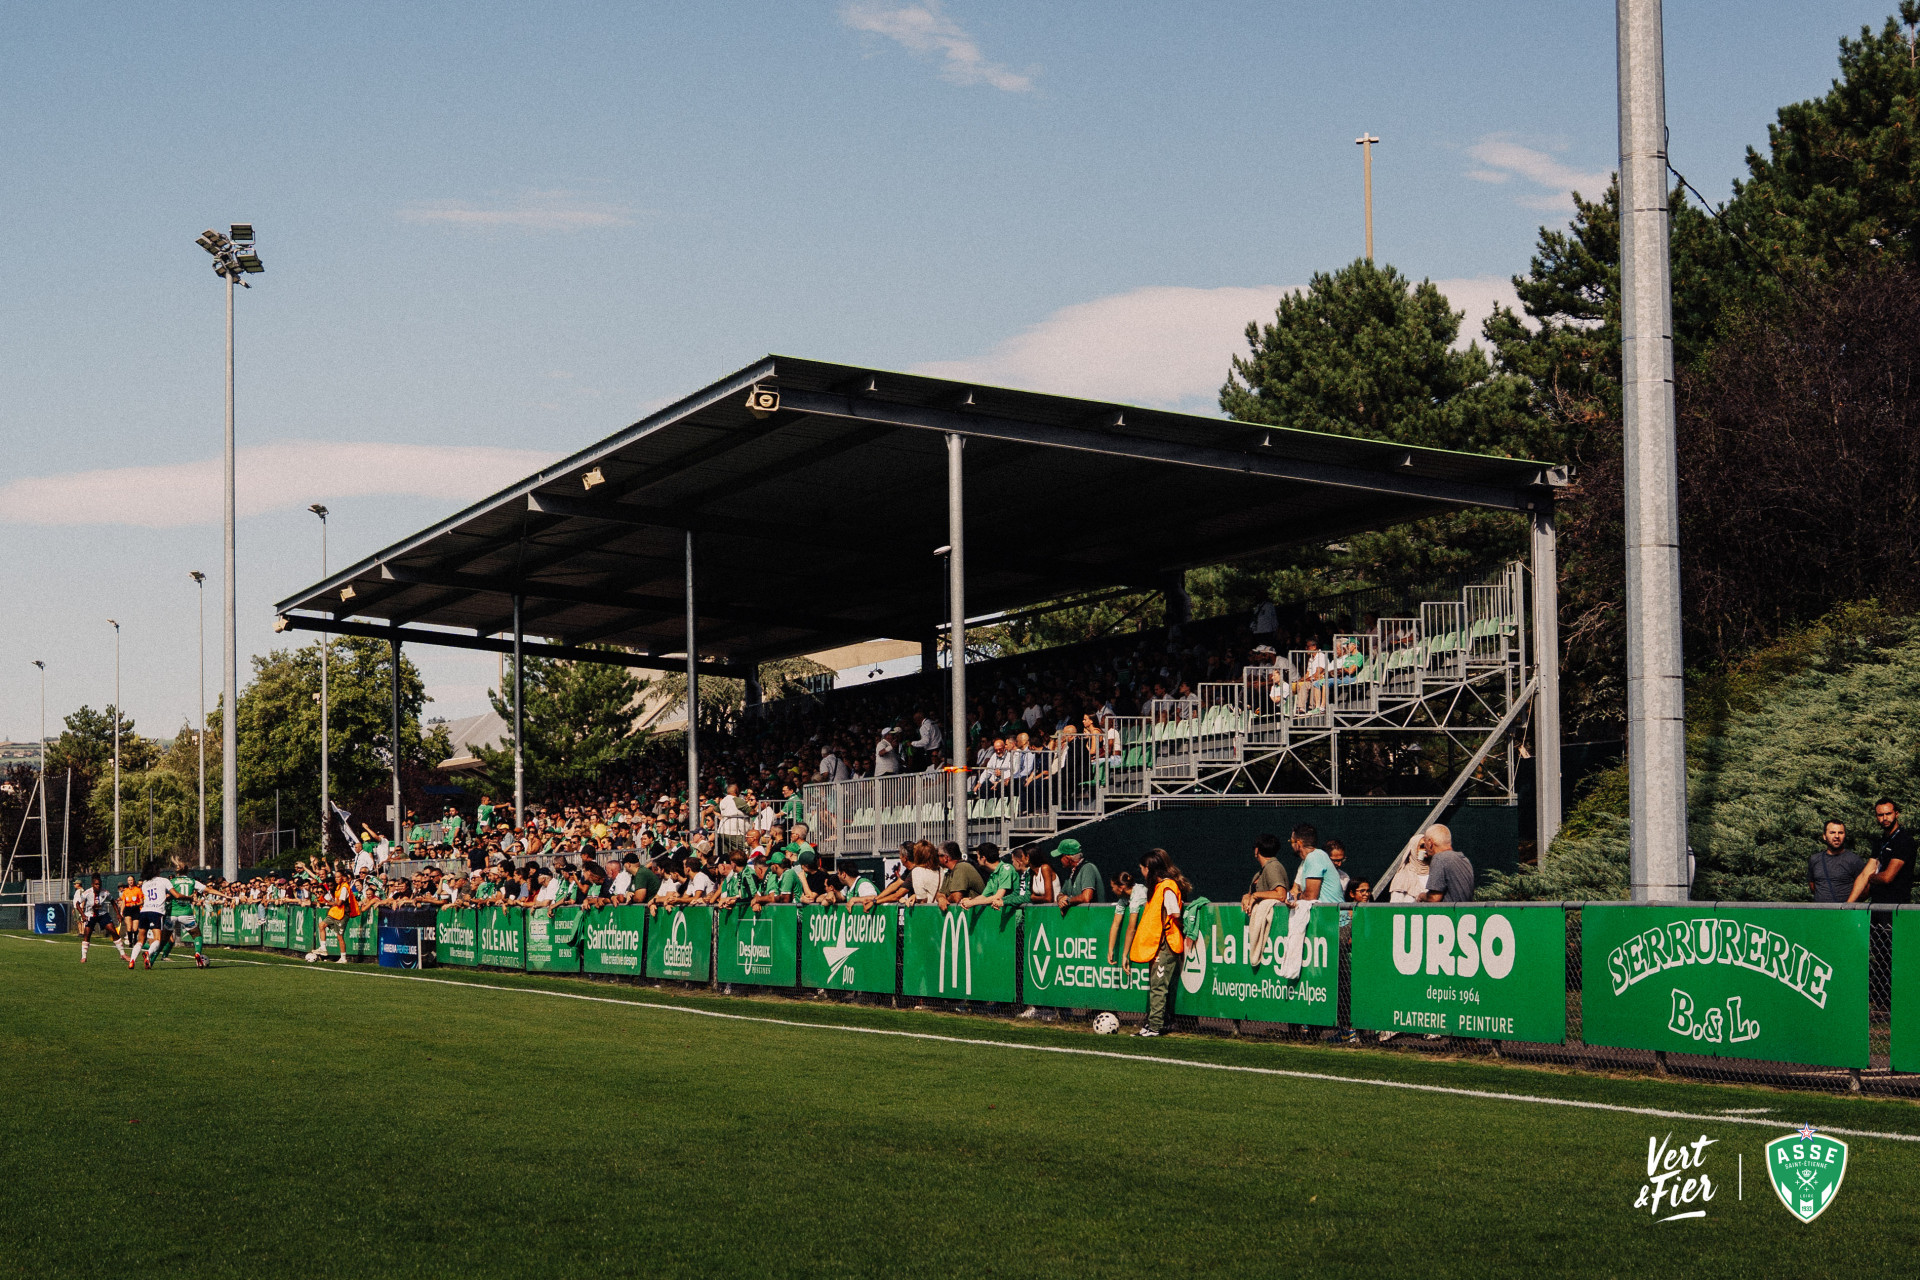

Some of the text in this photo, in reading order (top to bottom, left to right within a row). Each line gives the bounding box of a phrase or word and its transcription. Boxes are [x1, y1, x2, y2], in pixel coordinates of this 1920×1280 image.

[179, 883, 190, 897] 11
[809, 911, 886, 947] sport avenue
[1055, 937, 1097, 960] LOIRE
[1211, 924, 1237, 964] La
[1392, 913, 1516, 979] URSO
[842, 964, 855, 985] pro
[1607, 918, 1833, 1010] SERRURERIE
[1054, 965, 1150, 991] ASCENSEURS
[1212, 977, 1327, 1006] Auvergne-Rhône-Alpes
[1426, 984, 1480, 1005] depuis 1964
[1393, 1010, 1514, 1034] PLATRERIE PEINTURE
